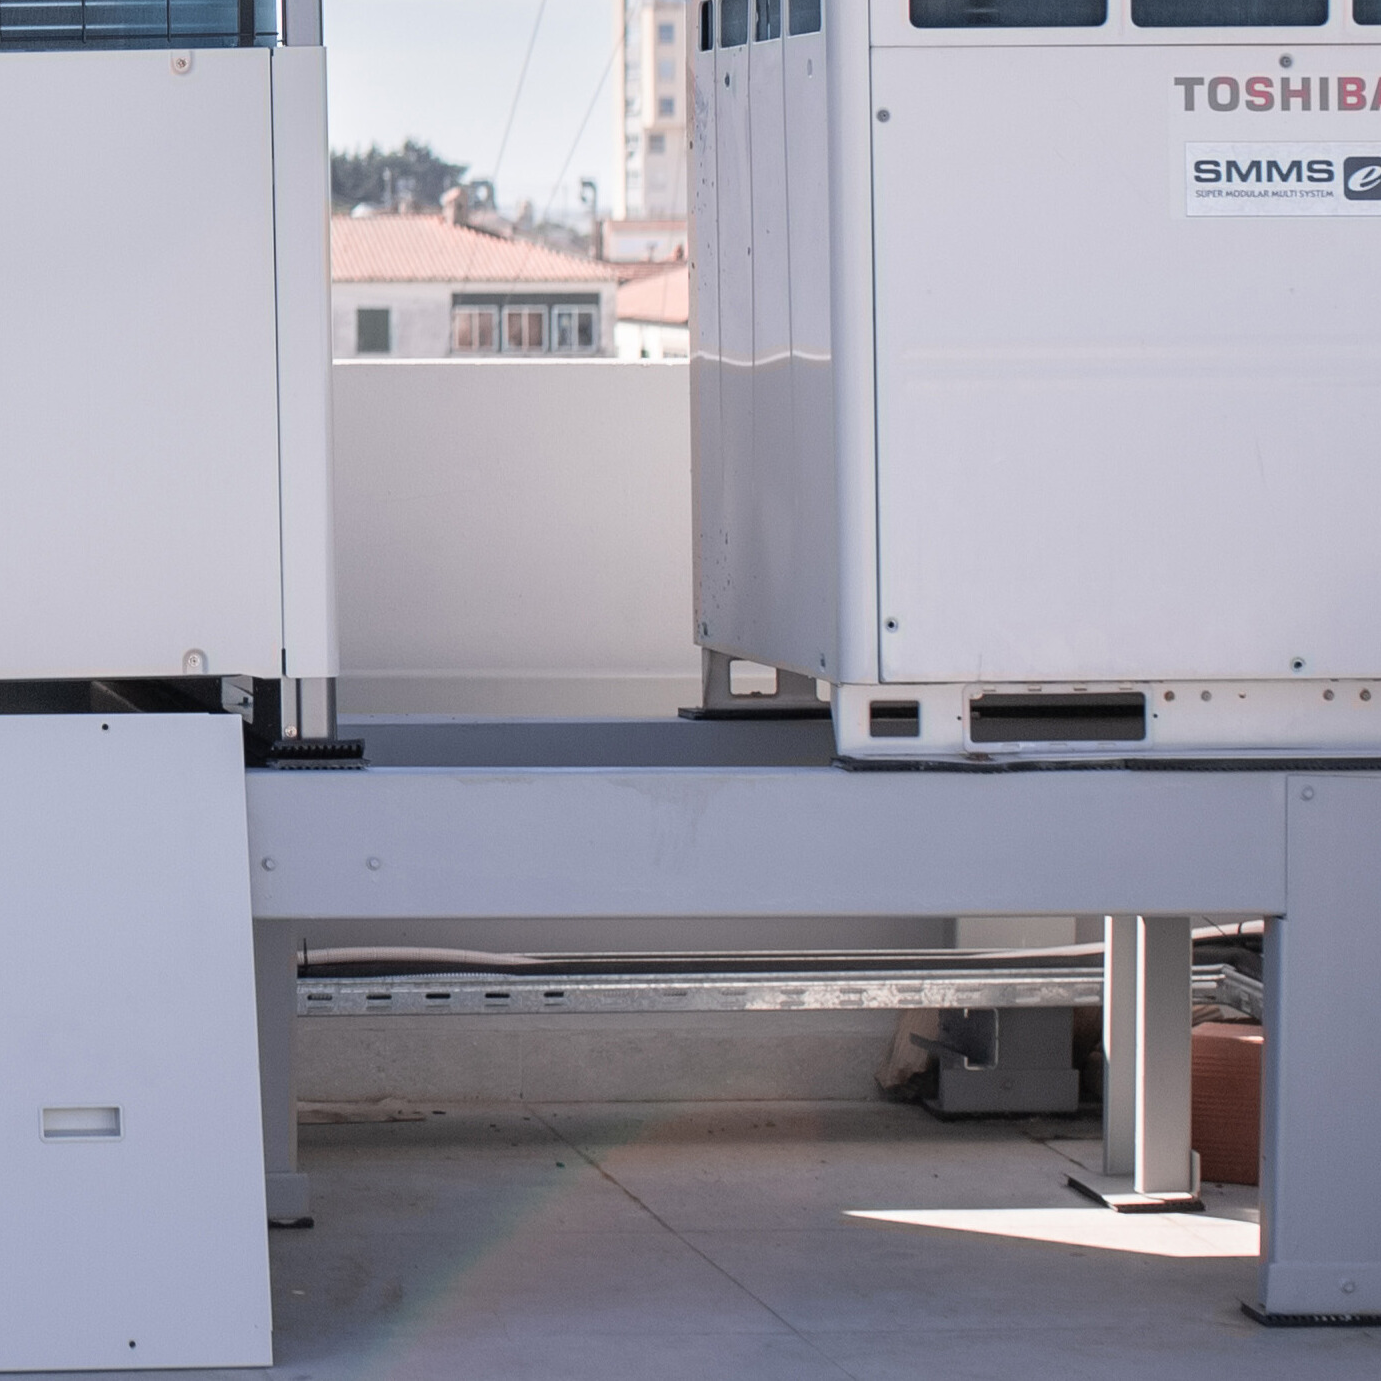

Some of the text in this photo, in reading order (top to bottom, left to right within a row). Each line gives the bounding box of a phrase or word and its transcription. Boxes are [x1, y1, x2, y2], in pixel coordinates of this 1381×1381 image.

[1194, 160, 1335, 183] SMMS
[1196, 190, 1334, 198] SUPER MODULAR MULTI SYSTEM
